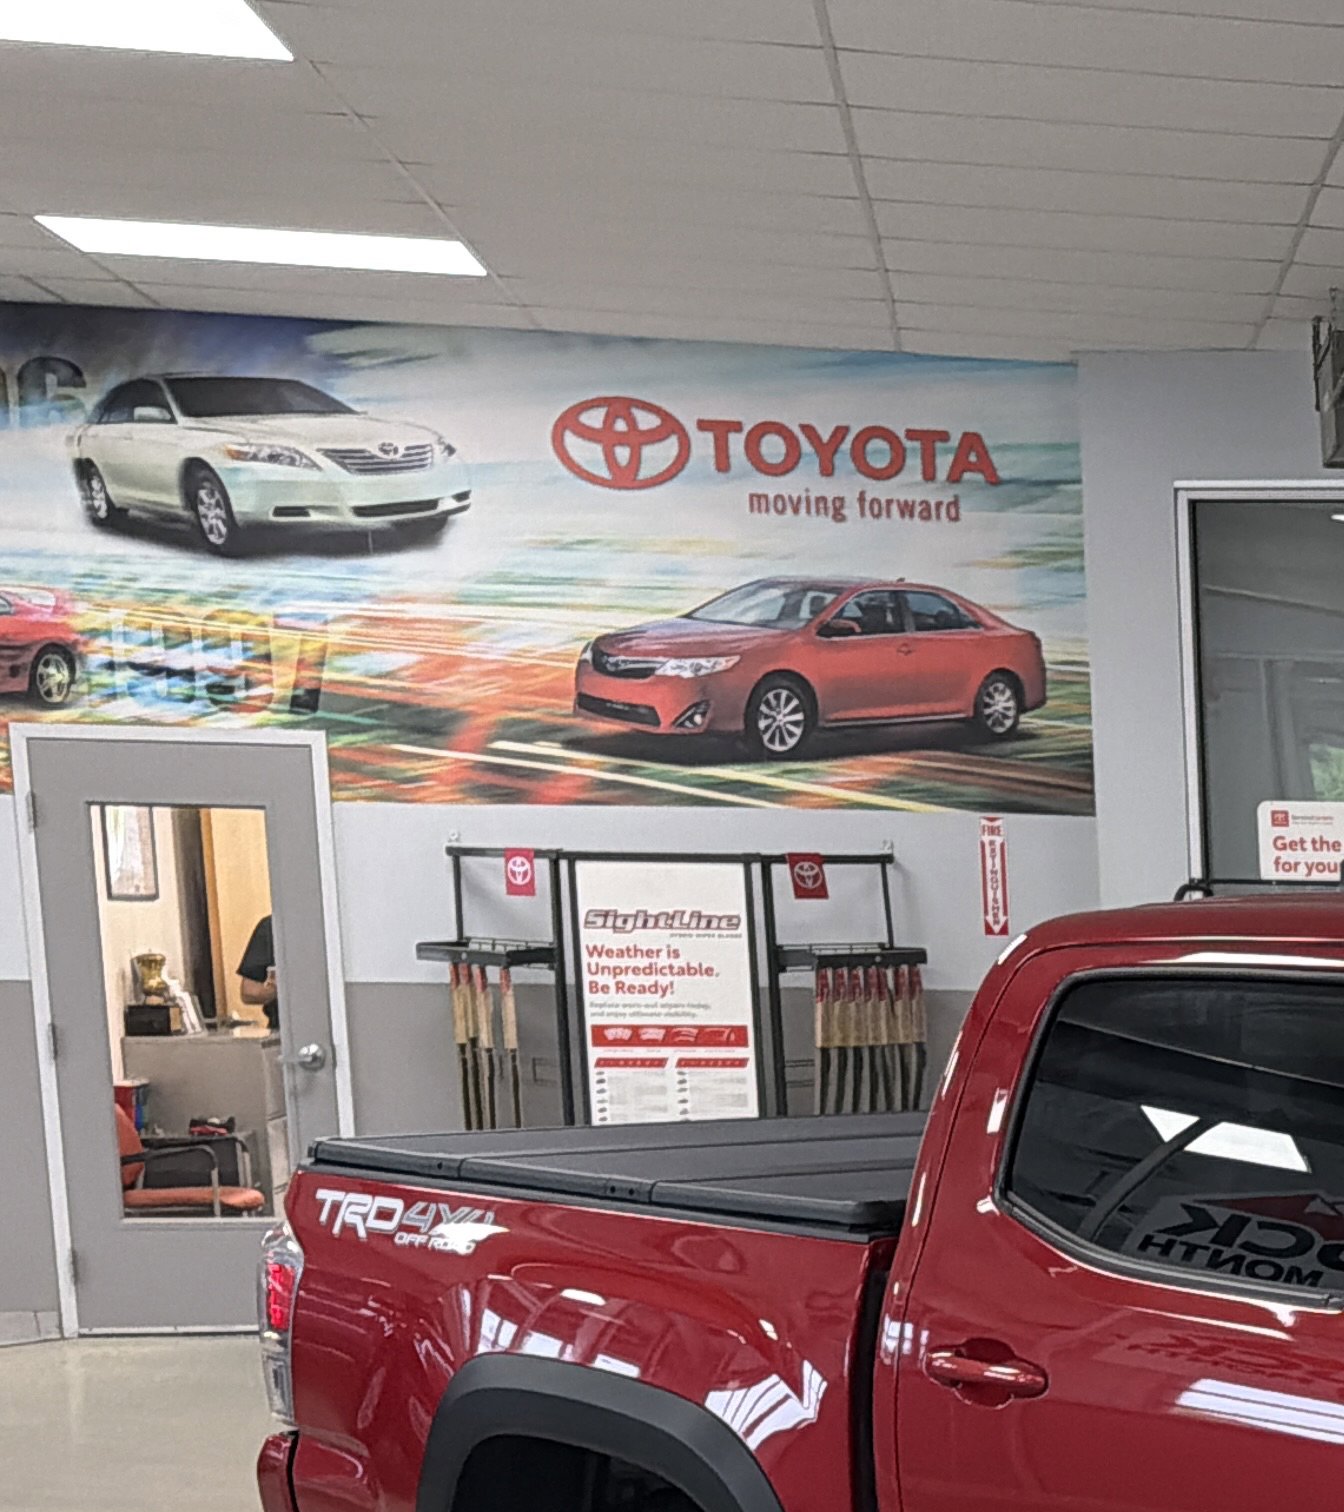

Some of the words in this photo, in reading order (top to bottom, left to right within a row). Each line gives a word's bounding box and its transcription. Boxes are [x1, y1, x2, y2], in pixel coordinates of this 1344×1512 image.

[697, 418, 1001, 486] TOYOTA
[749, 490, 846, 523] moving
[857, 490, 961, 523] forward
[981, 825, 1001, 836] FIRE
[1272, 836, 1307, 852] Get
[1311, 836, 1342, 853] the
[1273, 856, 1301, 874] for
[1305, 860, 1341, 877] you
[988, 840, 1000, 926] EXTINGUISHER
[585, 944, 662, 959] Weather
[667, 944, 680, 959] is
[587, 962, 720, 978] Unpredictable.
[588, 980, 610, 995] Be
[615, 980, 675, 998] Ready!
[315, 1188, 404, 1241] TRD
[393, 1231, 430, 1248] OFF
